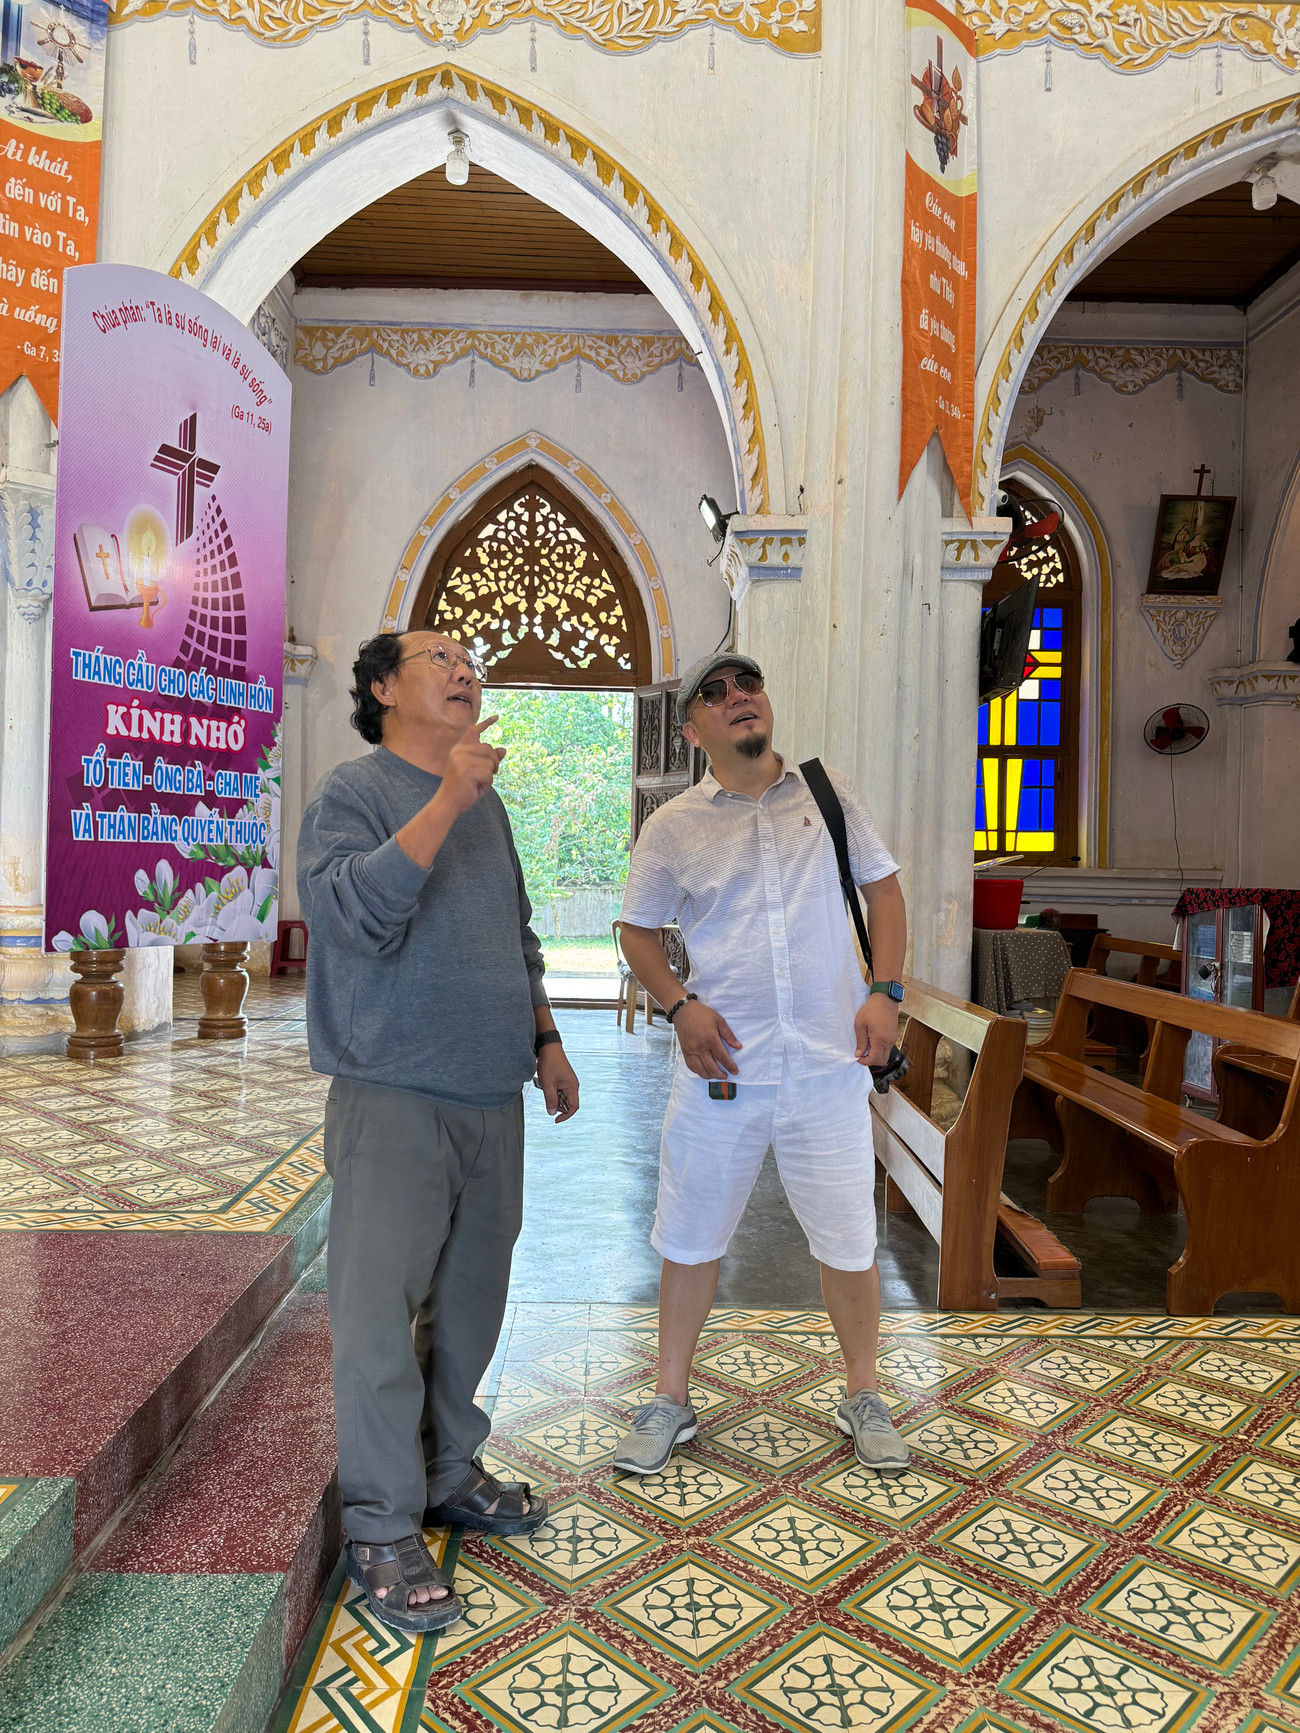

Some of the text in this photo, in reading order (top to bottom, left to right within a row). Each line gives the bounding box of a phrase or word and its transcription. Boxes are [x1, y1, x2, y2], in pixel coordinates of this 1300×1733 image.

[0, 139, 73, 183] Ai khát,
[5, 177, 89, 227] đến với Ta,
[24, 222, 52, 248] vào
[57, 230, 79, 261] Ta,
[911, 219, 923, 248] hãy
[924, 229, 935, 252] yêu
[0, 256, 58, 294] hãy đến
[14, 305, 59, 334] uống
[920, 308, 929, 331] đã
[930, 315, 939, 337] yêu
[23, 340, 37, 357] Ga
[39, 345, 49, 363] 7,
[52, 349, 61, 364] 3
[92, 305, 121, 334] Chúa
[118, 298, 146, 331] phán:
[163, 303, 173, 326] là
[175, 312, 186, 335] sự
[188, 315, 209, 348] sống
[210, 329, 223, 353] lại
[240, 364, 253, 383] sự
[231, 404, 272, 436] (Ga 11, 25a)
[71, 646, 274, 713] THÁNG CẦU CHO CÁC LINH HỒN
[106, 699, 246, 752] KÍNH NHỚ
[82, 743, 106, 787] TỔ
[107, 753, 142, 790] TIÊN
[153, 756, 183, 794] ÔNG
[185, 761, 204, 795] BÀ
[215, 770, 240, 798] CHA
[243, 773, 261, 804] MẸ
[71, 803, 267, 850] VÀ THÂN BẰNG QUYẾN THUỘC
